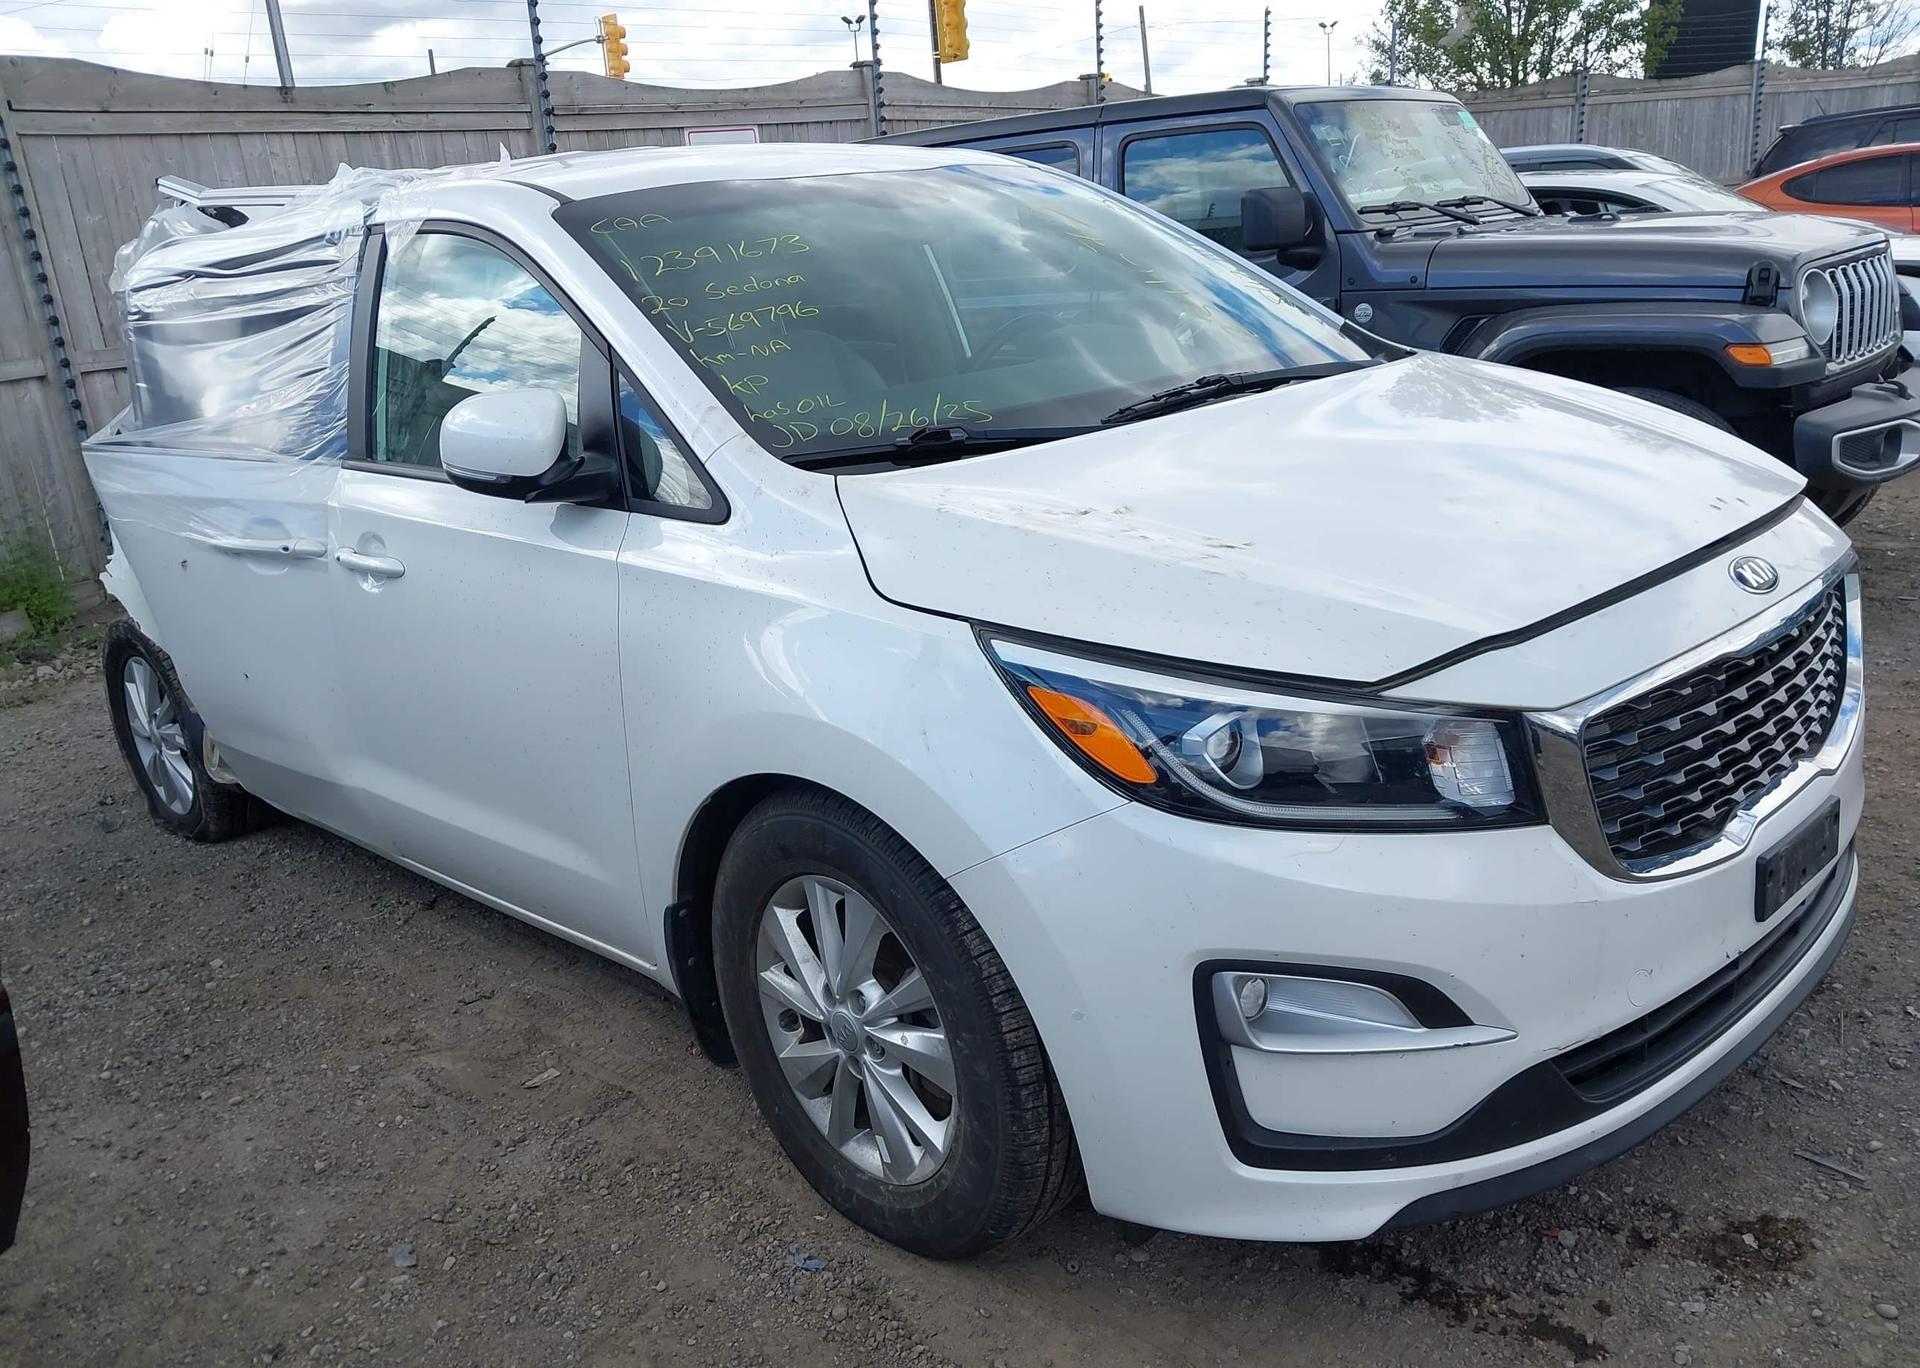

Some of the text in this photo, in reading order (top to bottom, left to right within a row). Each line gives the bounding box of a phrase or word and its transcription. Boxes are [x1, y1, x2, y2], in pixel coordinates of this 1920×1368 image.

[590, 213, 673, 234] CAA
[641, 273, 807, 314] 20 Sedona
[830, 392, 993, 438] 08/26/25
